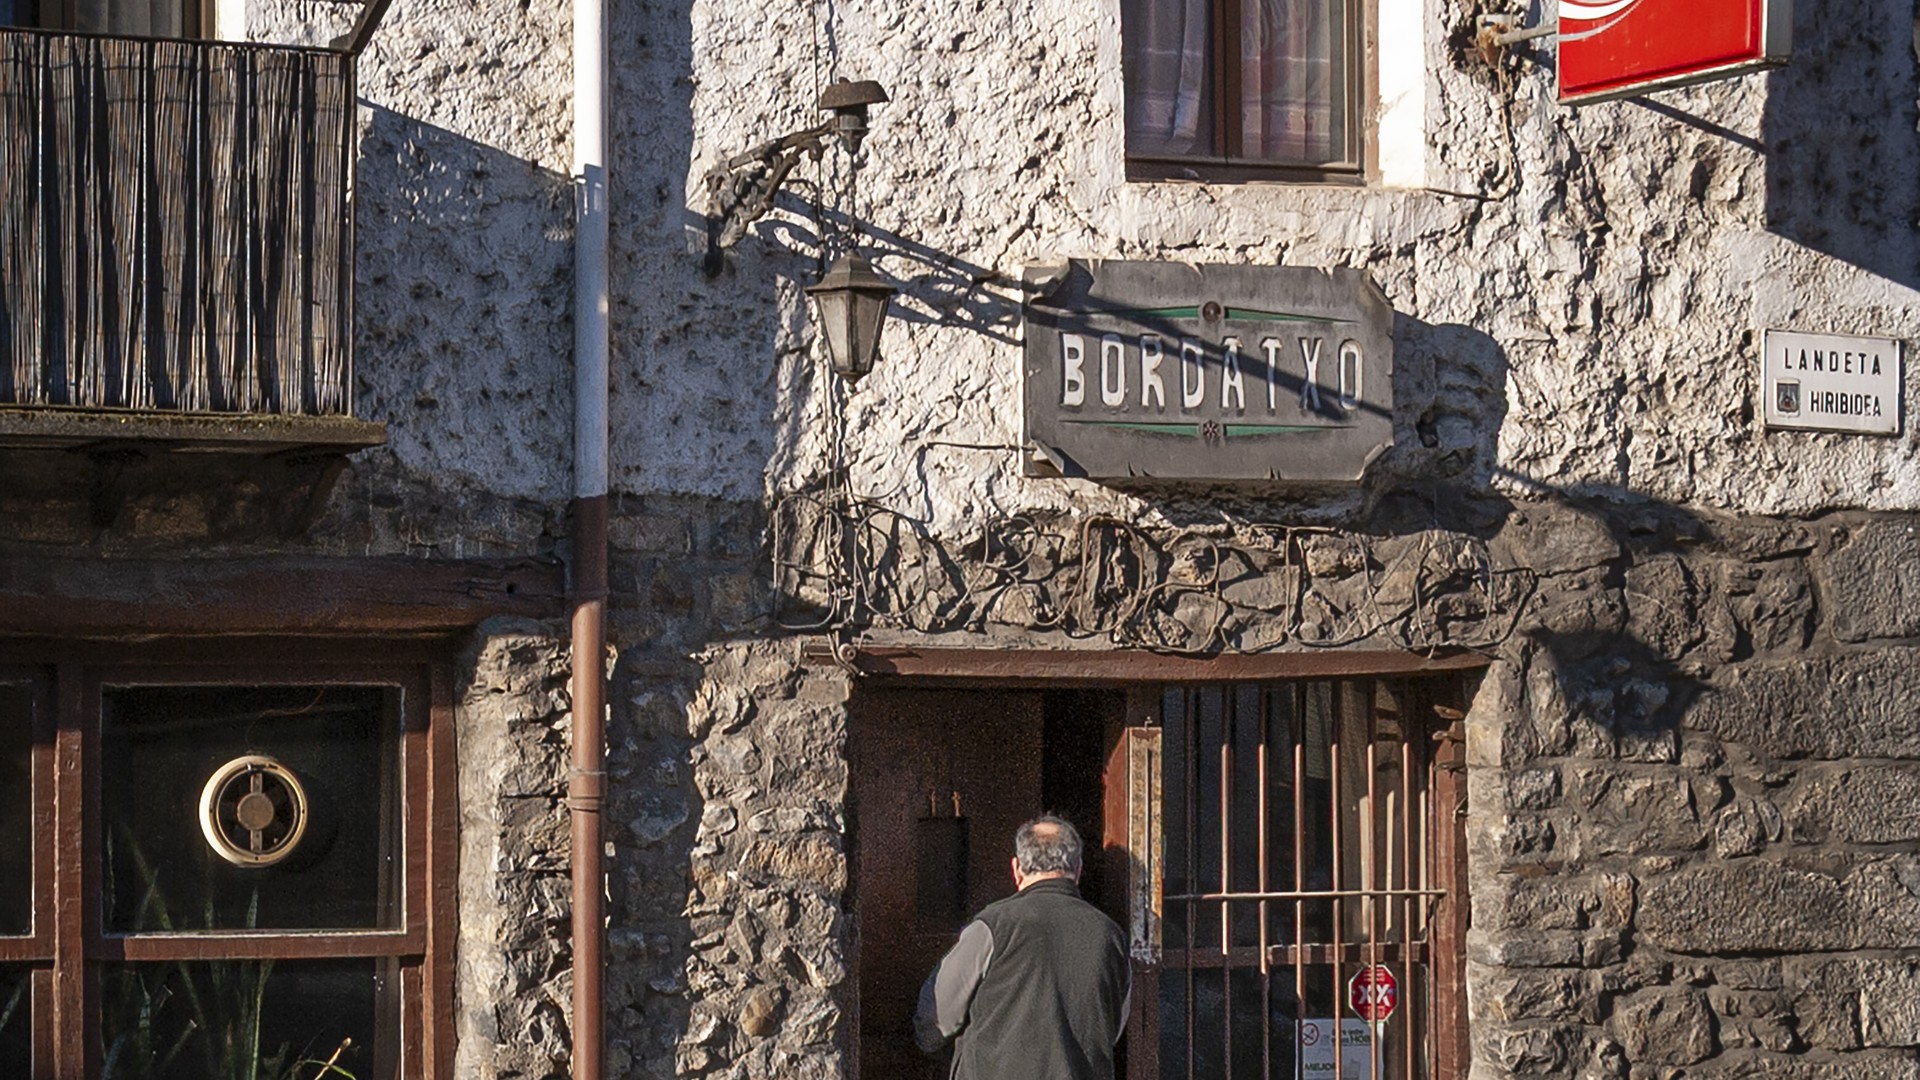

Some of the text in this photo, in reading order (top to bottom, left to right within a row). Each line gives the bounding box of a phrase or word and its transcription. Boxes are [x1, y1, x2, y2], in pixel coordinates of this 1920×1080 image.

[1060, 332, 1364, 411] BORDATXO
[1784, 347, 1882, 376] LANDETA
[1809, 390, 1882, 417] HIRIBIDEA
